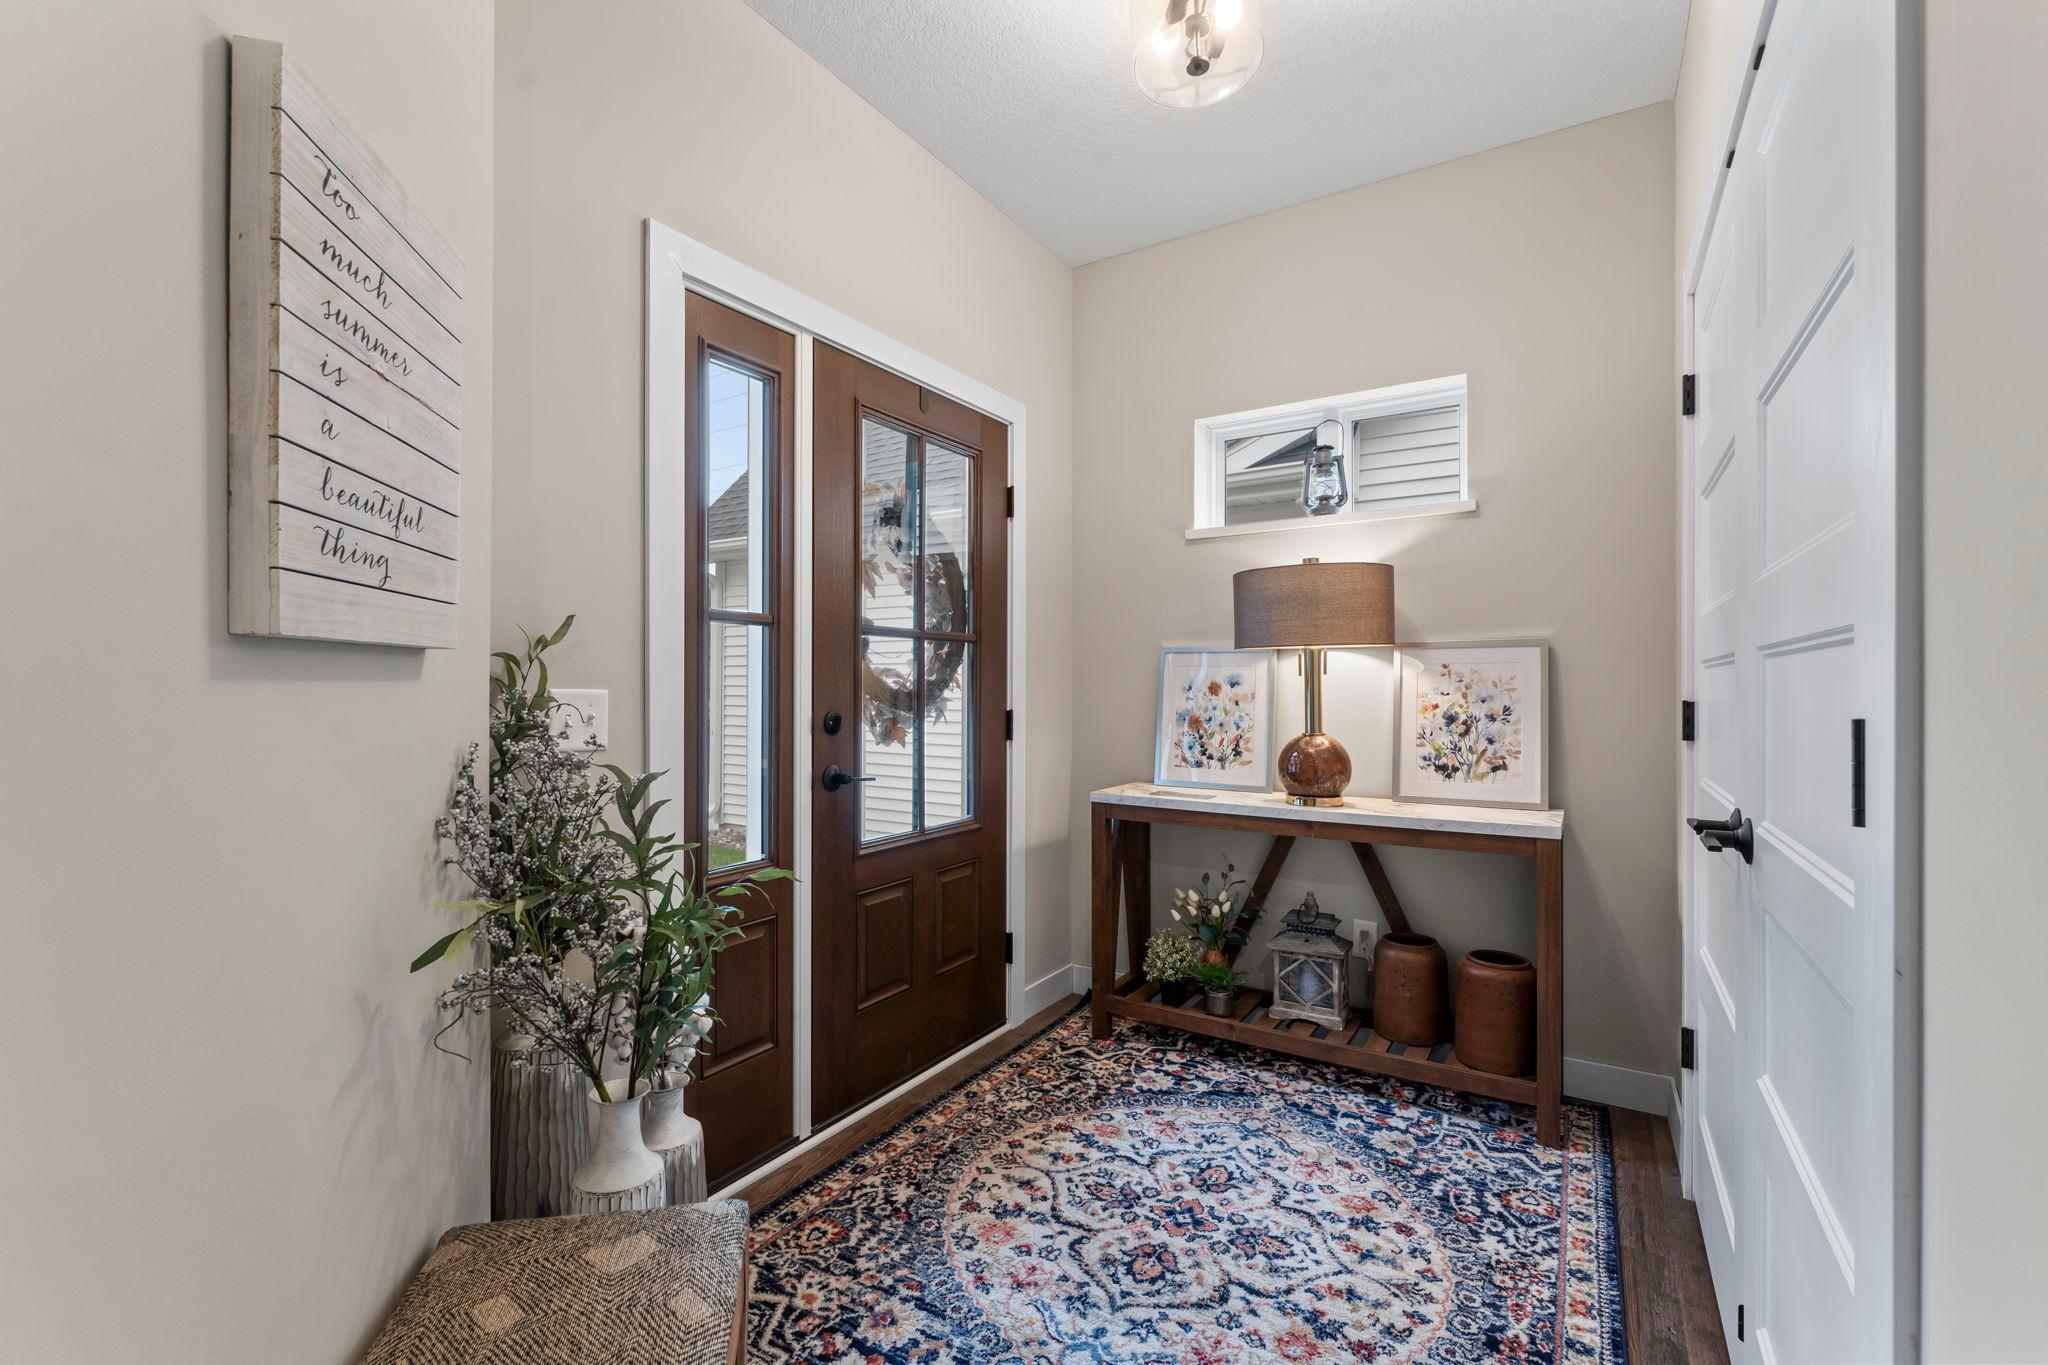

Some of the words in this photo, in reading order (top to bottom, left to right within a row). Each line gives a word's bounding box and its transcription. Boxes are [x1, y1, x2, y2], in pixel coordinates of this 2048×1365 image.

[314, 155, 360, 221] too
[319, 238, 392, 310] much
[319, 355, 347, 387] is
[321, 300, 413, 376] summer
[321, 418, 340, 441] a
[320, 466, 424, 537] beautiful
[313, 526, 391, 587] thing
